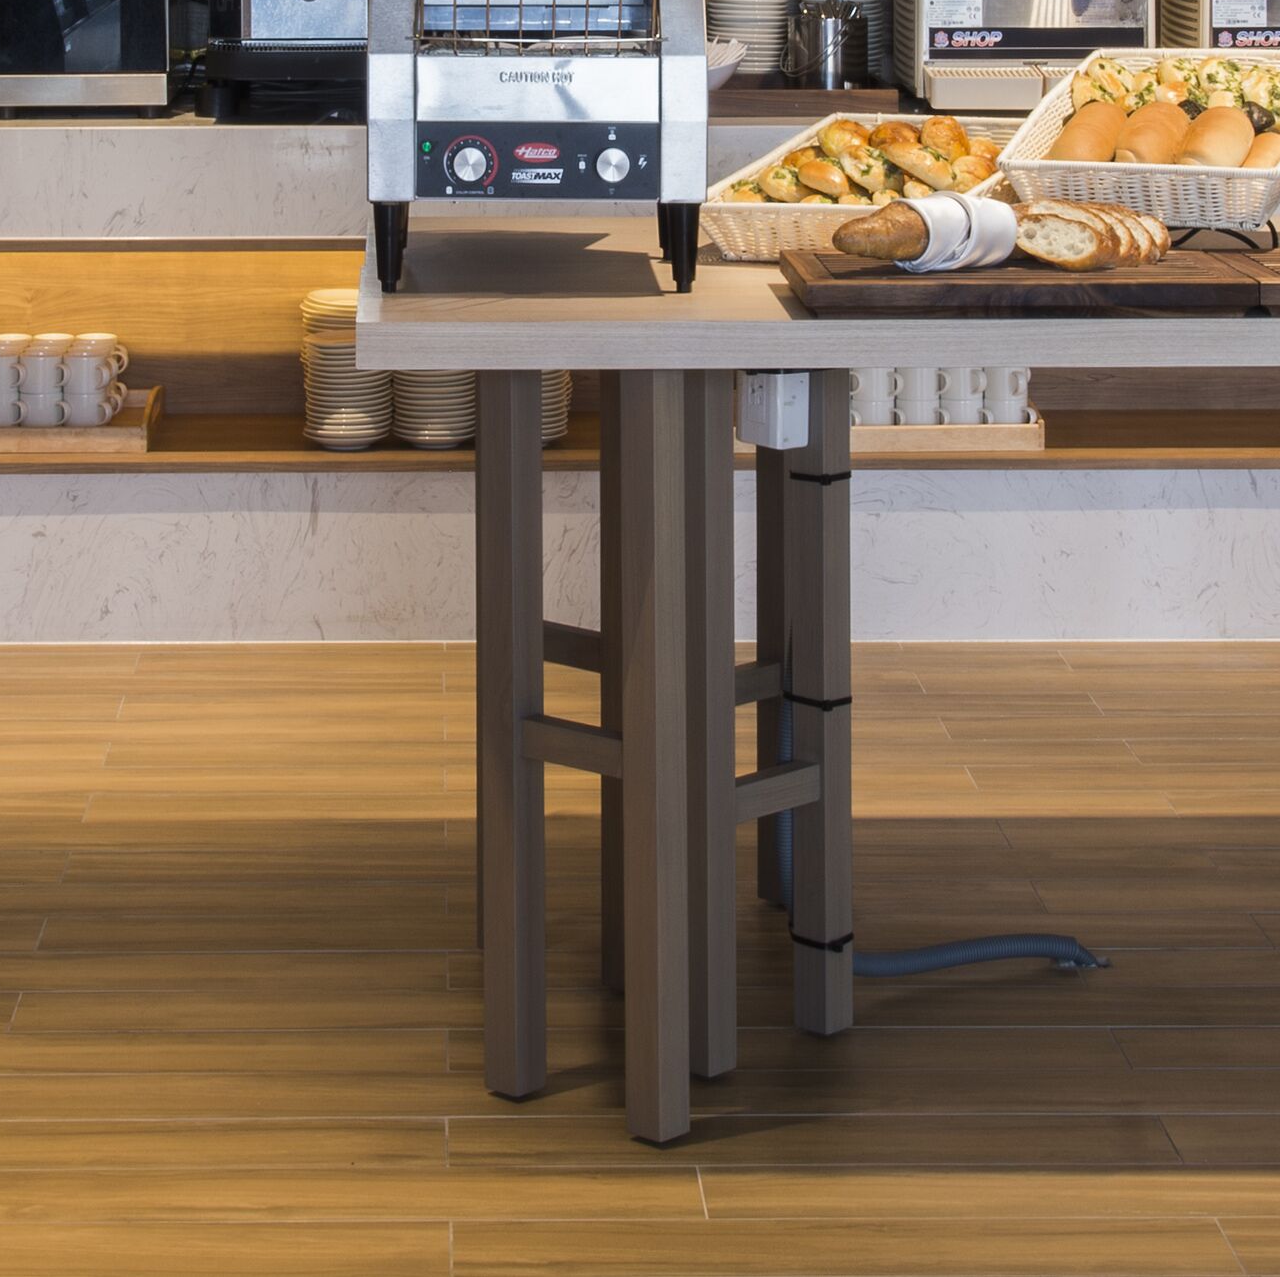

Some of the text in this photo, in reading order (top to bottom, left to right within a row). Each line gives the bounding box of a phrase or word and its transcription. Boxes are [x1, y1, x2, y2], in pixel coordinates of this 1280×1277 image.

[951, 30, 1003, 48] SHOP
[499, 70, 575, 83] CAUTION HOT
[515, 146, 558, 158] Hatco
